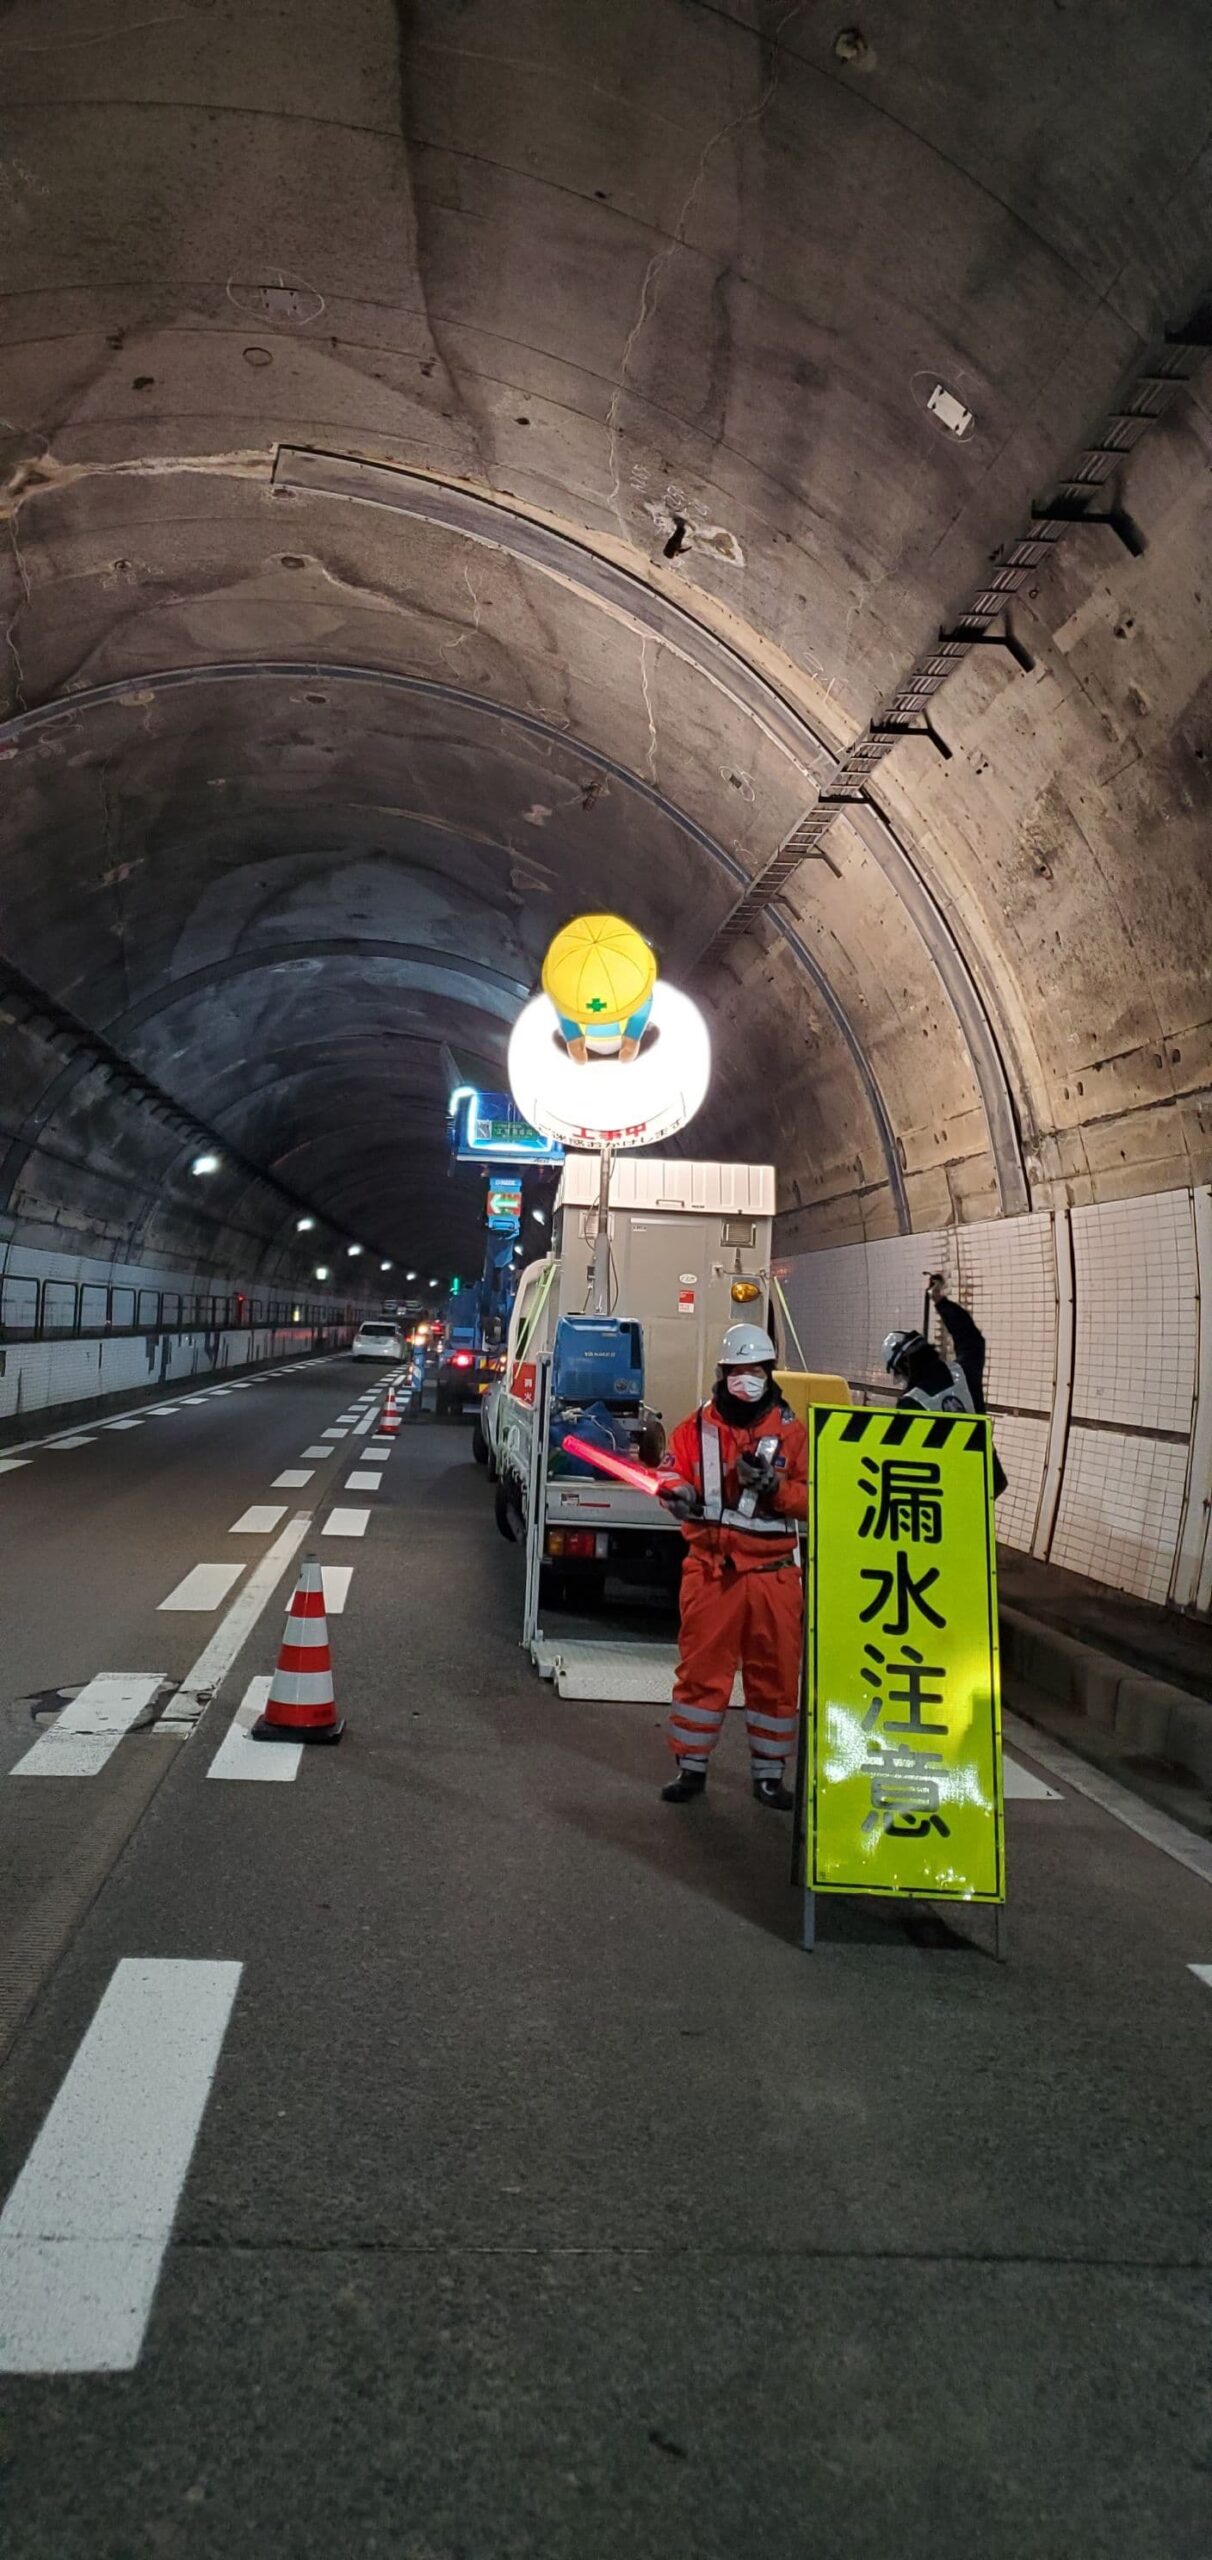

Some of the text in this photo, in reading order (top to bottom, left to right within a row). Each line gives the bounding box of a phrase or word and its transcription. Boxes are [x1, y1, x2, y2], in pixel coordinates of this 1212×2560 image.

[572, 1122, 647, 1141] 工事中
[857, 1456, 951, 1838] 漏水注意
